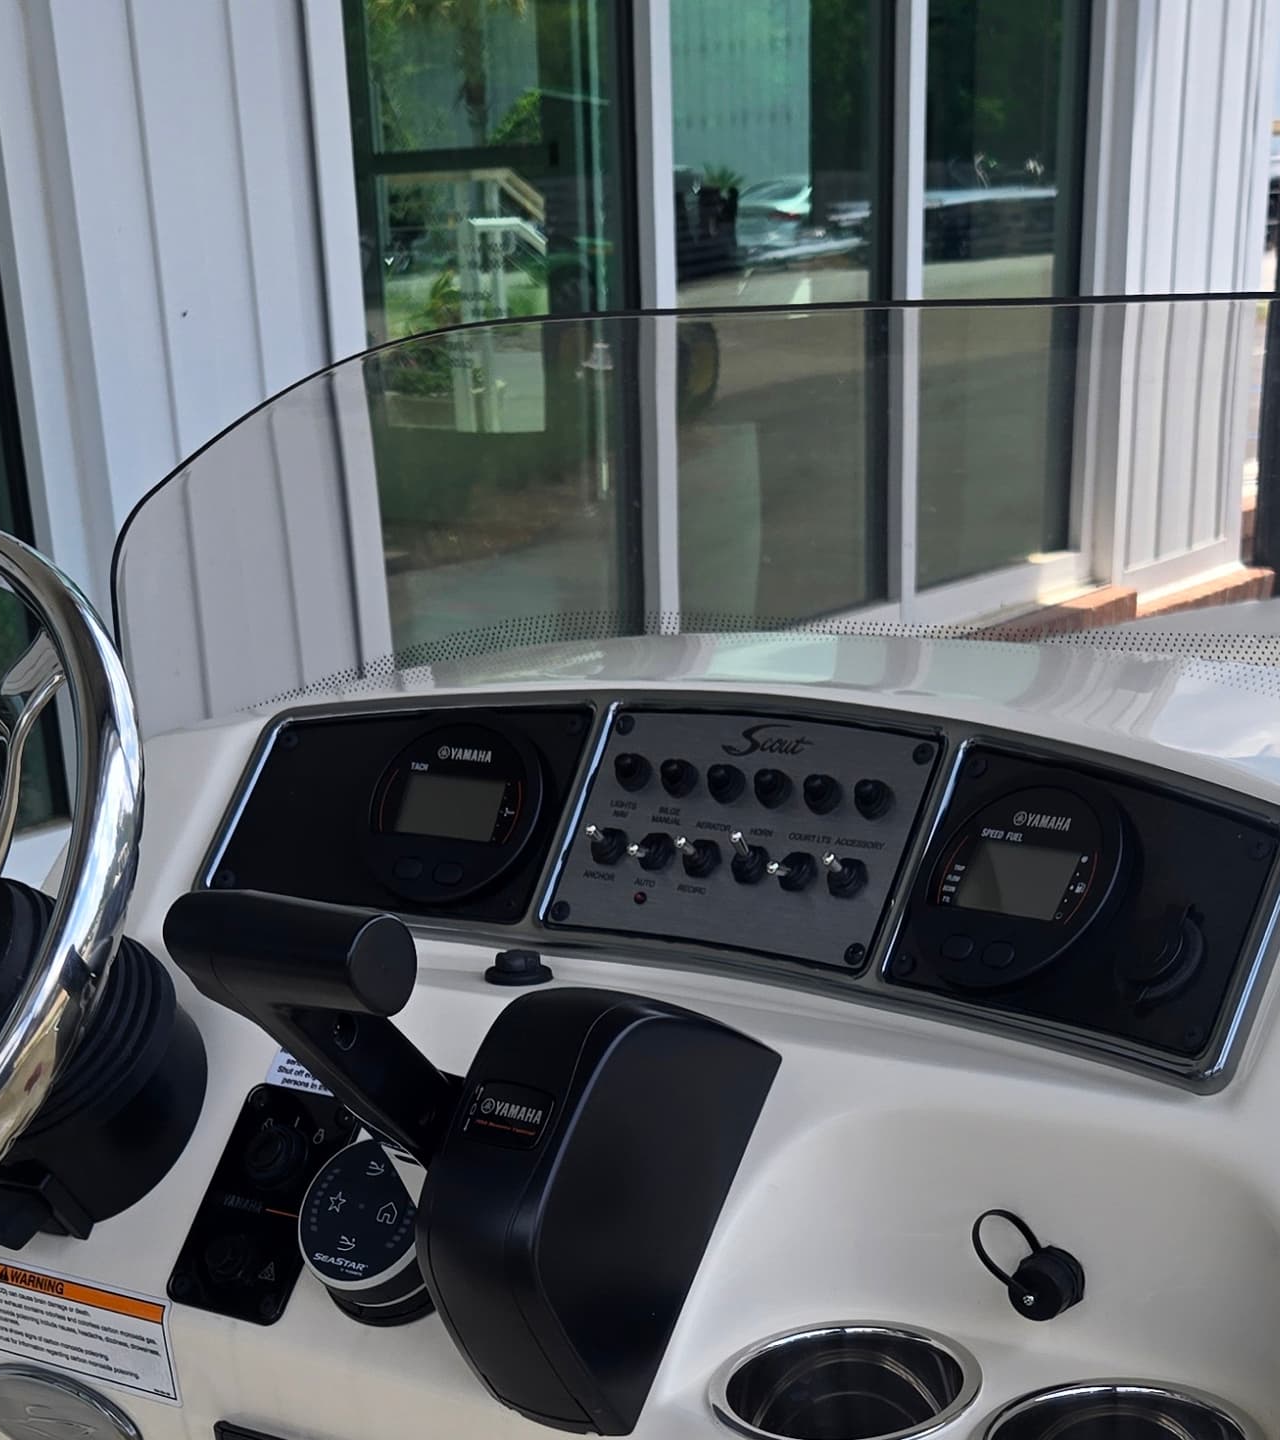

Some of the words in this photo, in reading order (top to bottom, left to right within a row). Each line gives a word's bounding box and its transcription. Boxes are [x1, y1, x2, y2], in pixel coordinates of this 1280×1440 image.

[721, 724, 814, 757] Scout
[450, 748, 492, 763] YAMAHA
[411, 761, 429, 771] TACH
[610, 800, 637, 811] LIGHTS
[659, 806, 680, 816] BILGE
[613, 810, 629, 819] NAV
[651, 815, 681, 826] MANUAL
[1026, 813, 1072, 832] YAMAHA
[696, 821, 731, 833] AERATOR
[750, 828, 773, 838] HORN
[788, 832, 816, 844] COURT
[981, 828, 1003, 839] SPEED
[1005, 832, 1023, 842] FUEL
[835, 838, 886, 850] ACCESSORY
[583, 871, 615, 882] ANCHOR
[634, 878, 655, 888] AUTO
[677, 884, 706, 895] RECIRC
[495, 1101, 543, 1125] YAMAHA
[9, 1270, 64, 1295] WARNING
